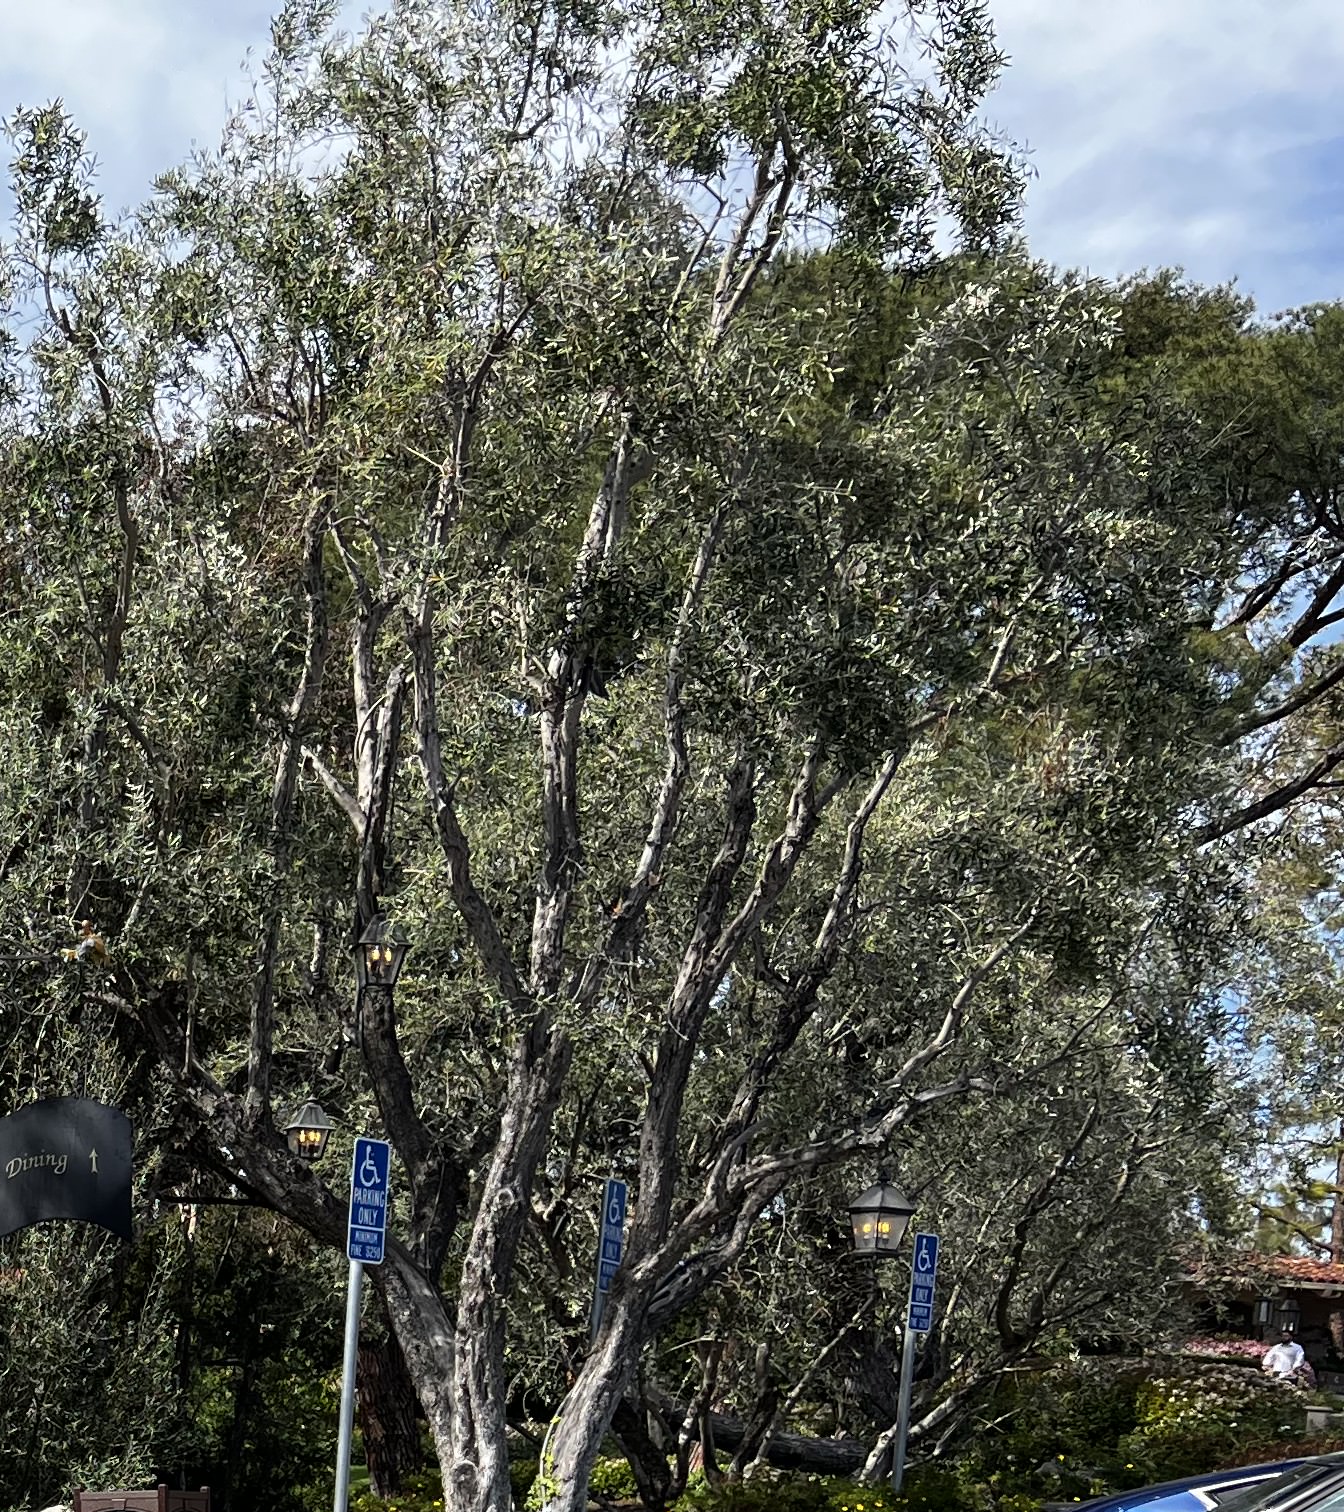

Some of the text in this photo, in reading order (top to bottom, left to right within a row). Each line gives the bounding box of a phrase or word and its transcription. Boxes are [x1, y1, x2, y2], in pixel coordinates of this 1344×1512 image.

[5, 1149, 68, 1179] Dining
[354, 1187, 385, 1208] PARKING
[358, 1206, 378, 1226] ONLY
